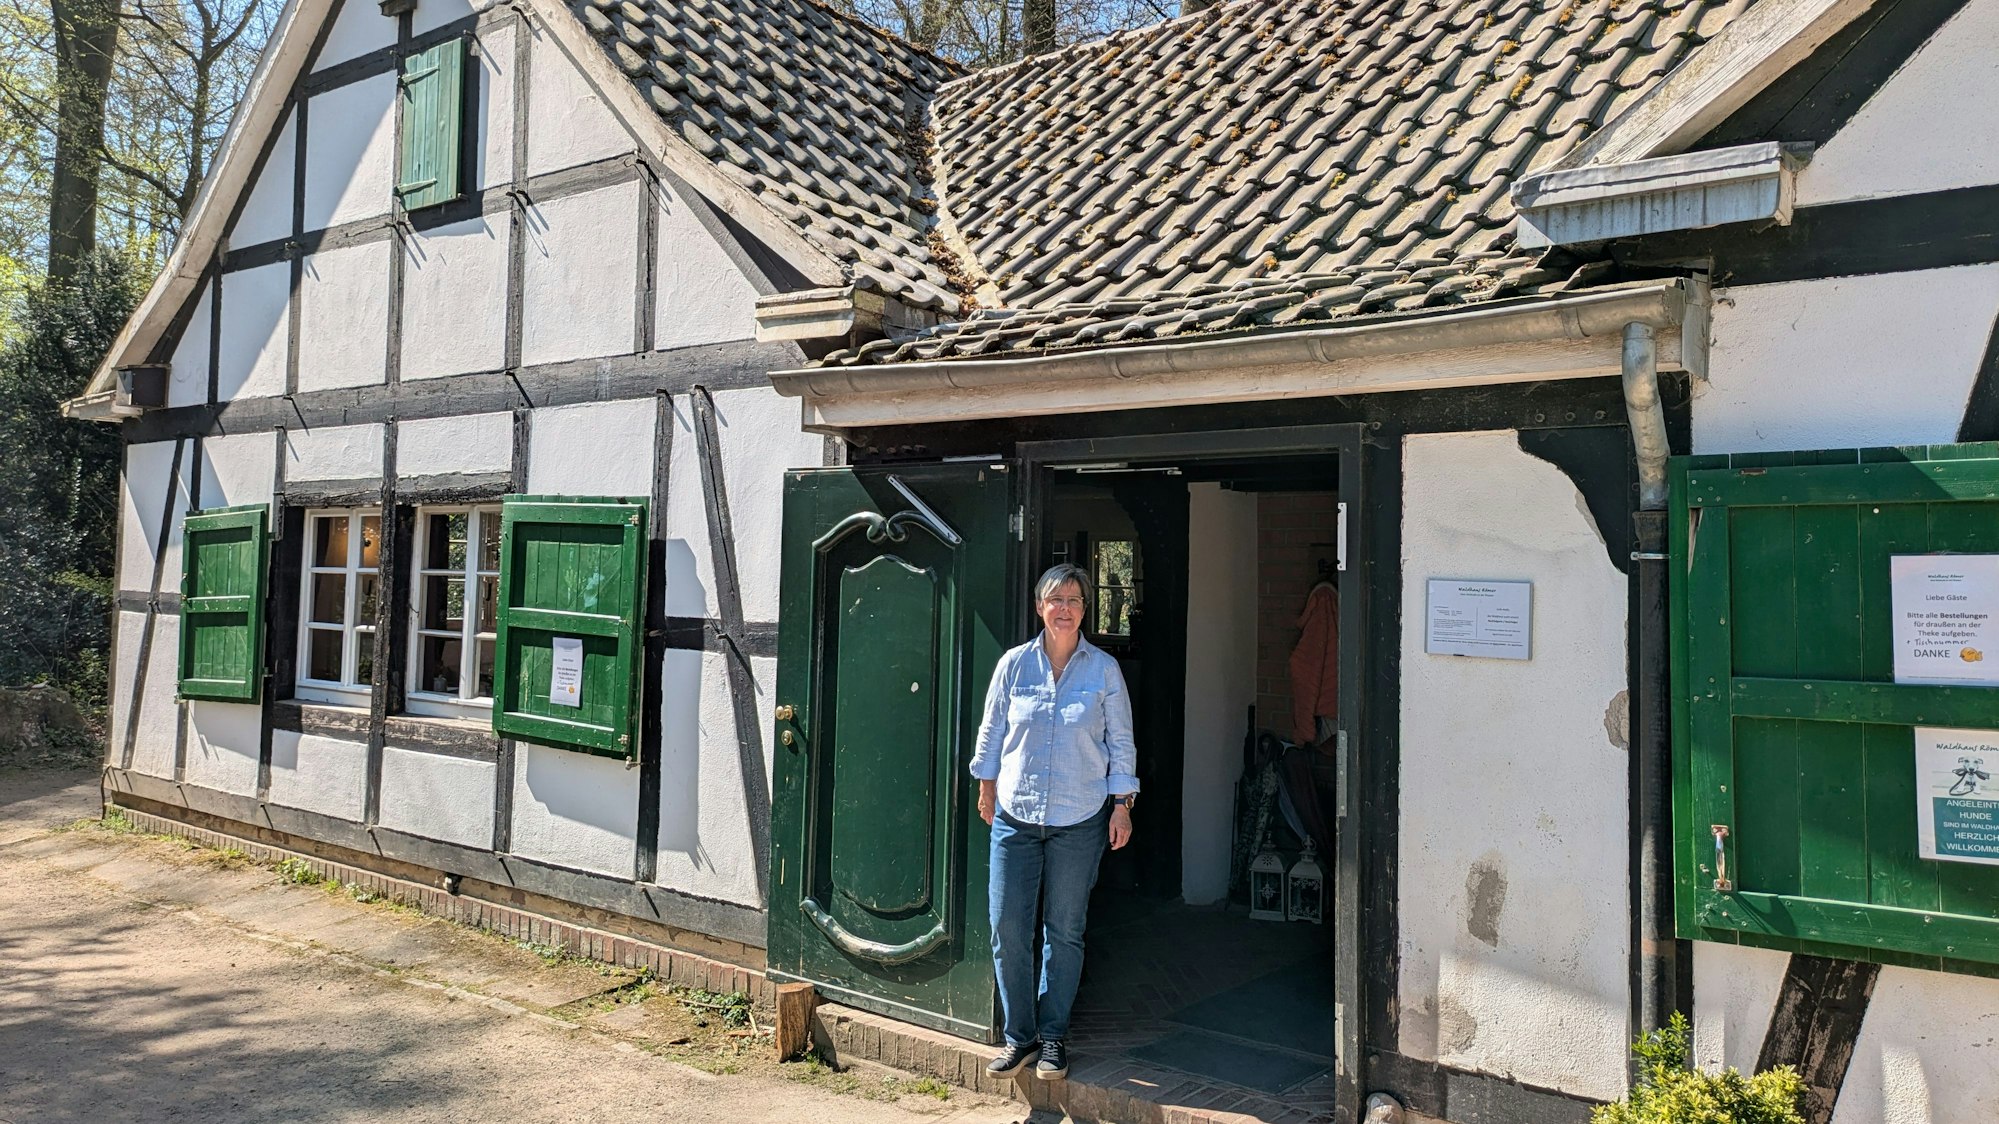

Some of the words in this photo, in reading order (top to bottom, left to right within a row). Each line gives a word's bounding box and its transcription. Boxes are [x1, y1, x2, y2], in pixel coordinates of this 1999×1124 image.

[1940, 612, 1988, 620] Bestellungen
[1941, 630, 1978, 638] aufgeben.
[1914, 649, 1950, 658] DANKE
[1936, 742, 1978, 752] Waldhaus
[1959, 811, 1993, 820] HUNDE
[1954, 831, 1999, 842] HERZLICH
